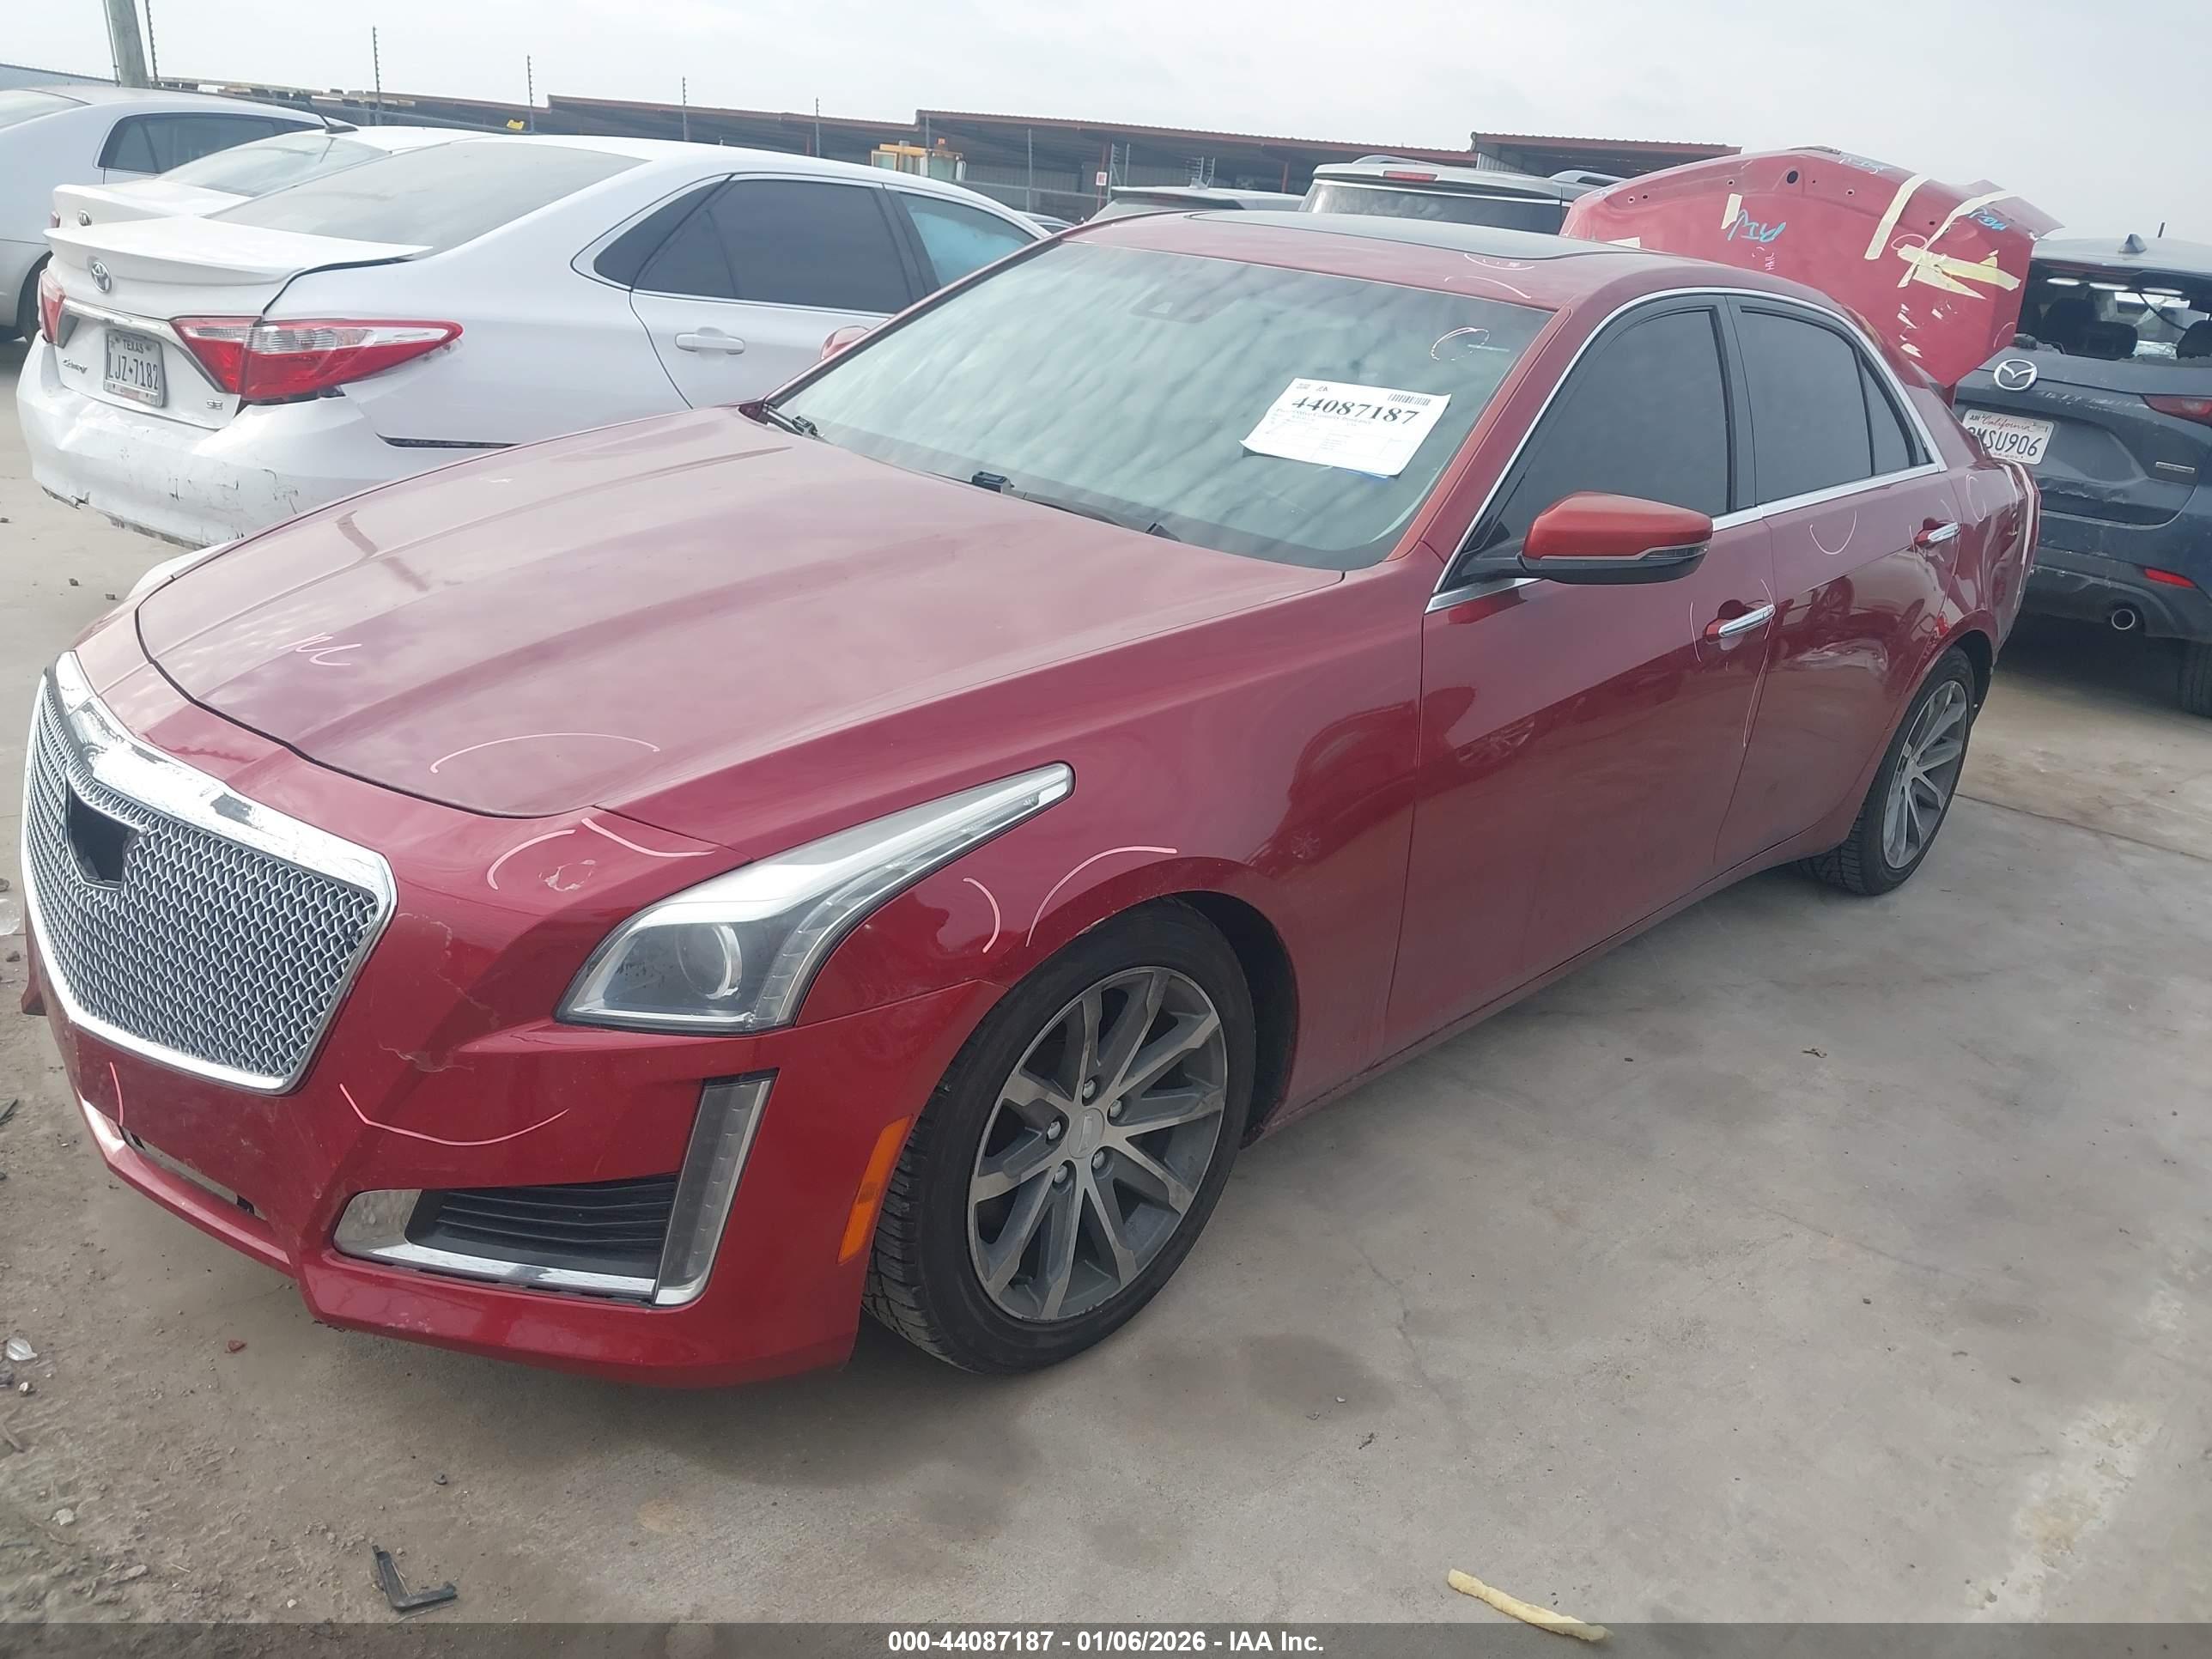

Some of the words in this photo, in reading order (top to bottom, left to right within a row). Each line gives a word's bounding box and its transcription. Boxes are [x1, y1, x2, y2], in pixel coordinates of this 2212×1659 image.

[123, 338, 144, 354] TEXAS
[1291, 396, 1420, 425] 44087187
[1981, 415, 2033, 432] California
[1966, 427, 2042, 457] MSU906
